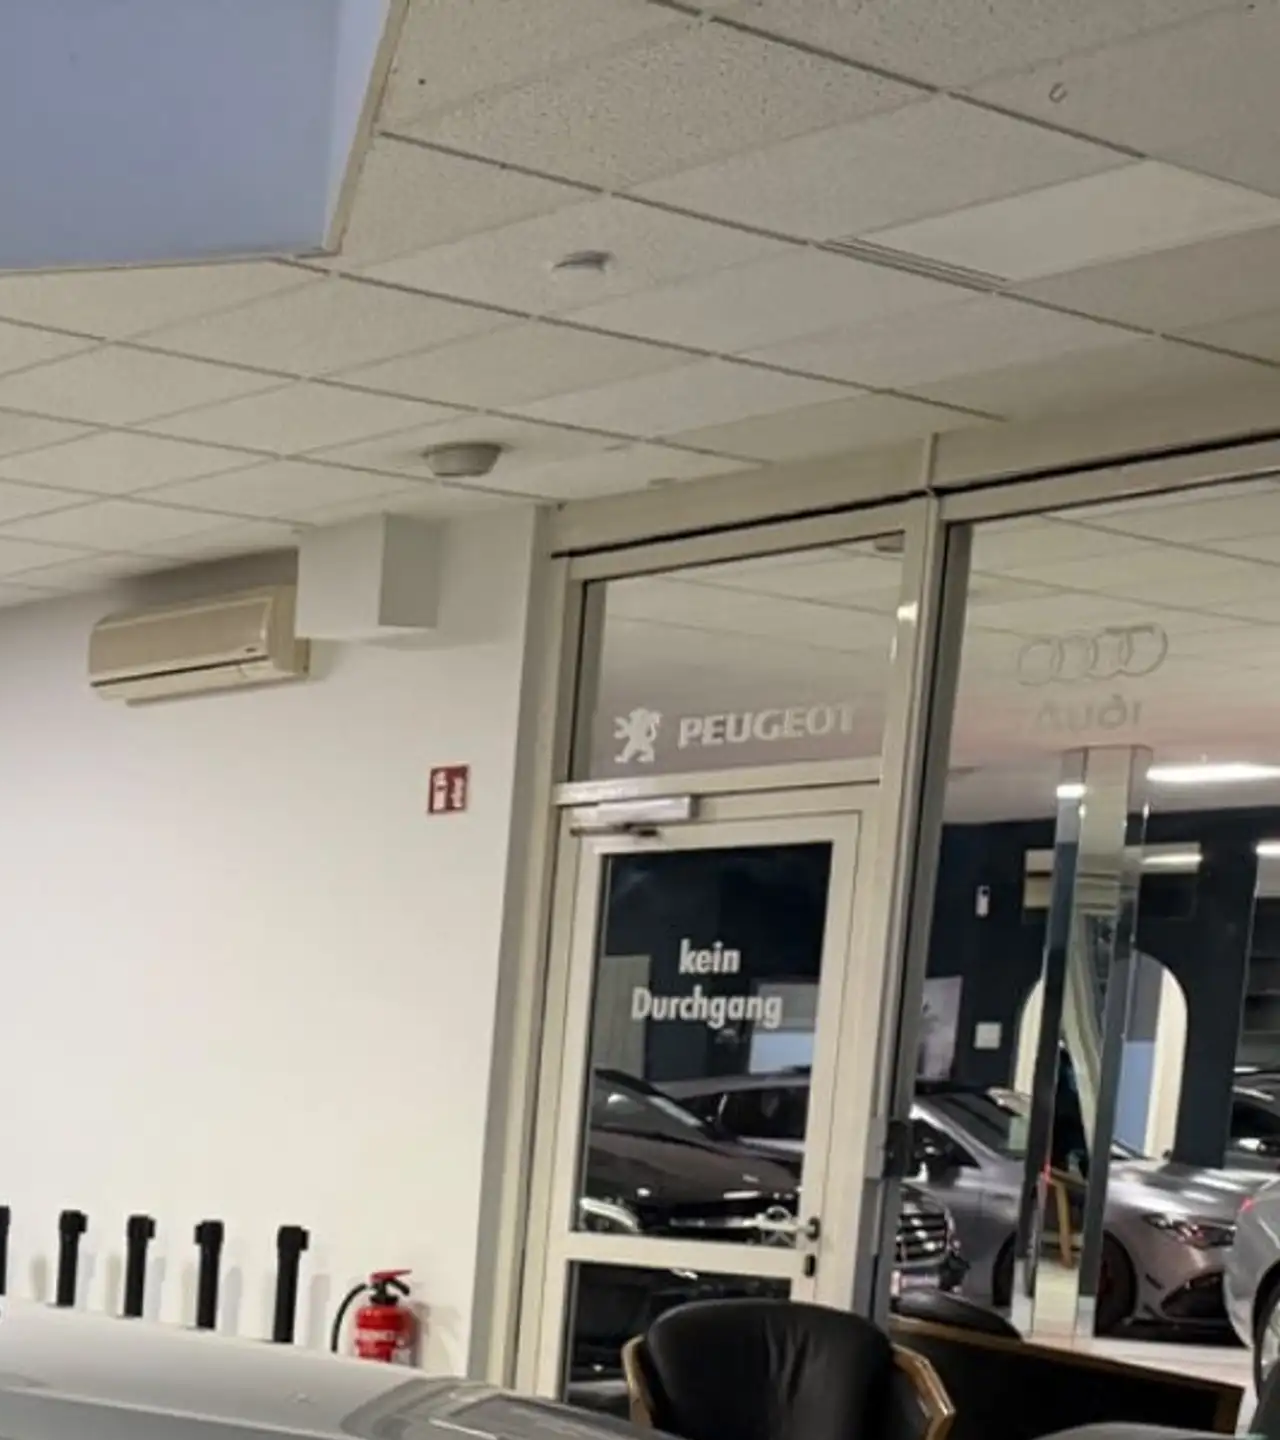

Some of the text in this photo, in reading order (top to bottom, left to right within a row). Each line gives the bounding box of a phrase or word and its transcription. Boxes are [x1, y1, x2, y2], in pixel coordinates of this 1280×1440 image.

[677, 702, 856, 750] PEUGEOT
[679, 938, 741, 974] kein
[631, 984, 783, 1029] Durchgang
